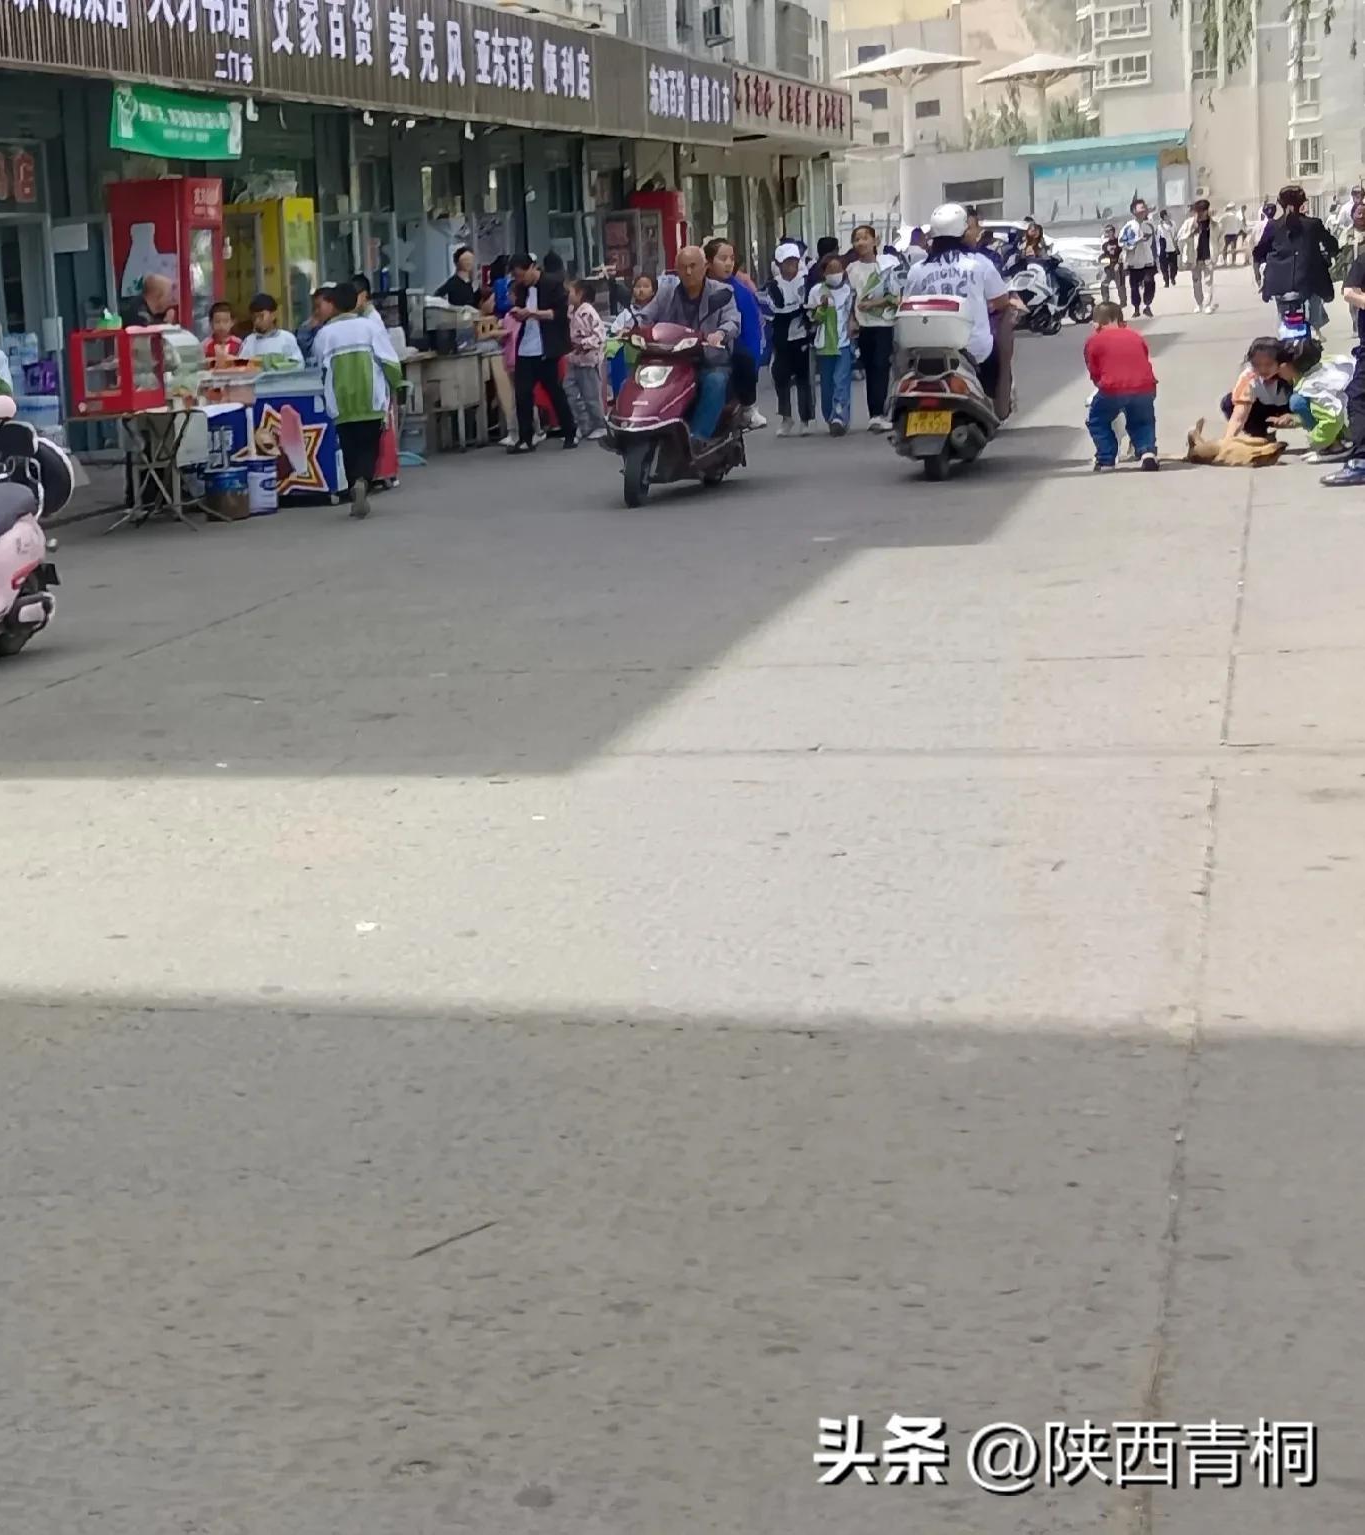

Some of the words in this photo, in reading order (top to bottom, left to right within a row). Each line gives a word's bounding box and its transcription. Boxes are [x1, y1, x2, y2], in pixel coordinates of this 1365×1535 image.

[388, 6, 465, 87] 麦克风
[542, 39, 591, 100] 便利店
